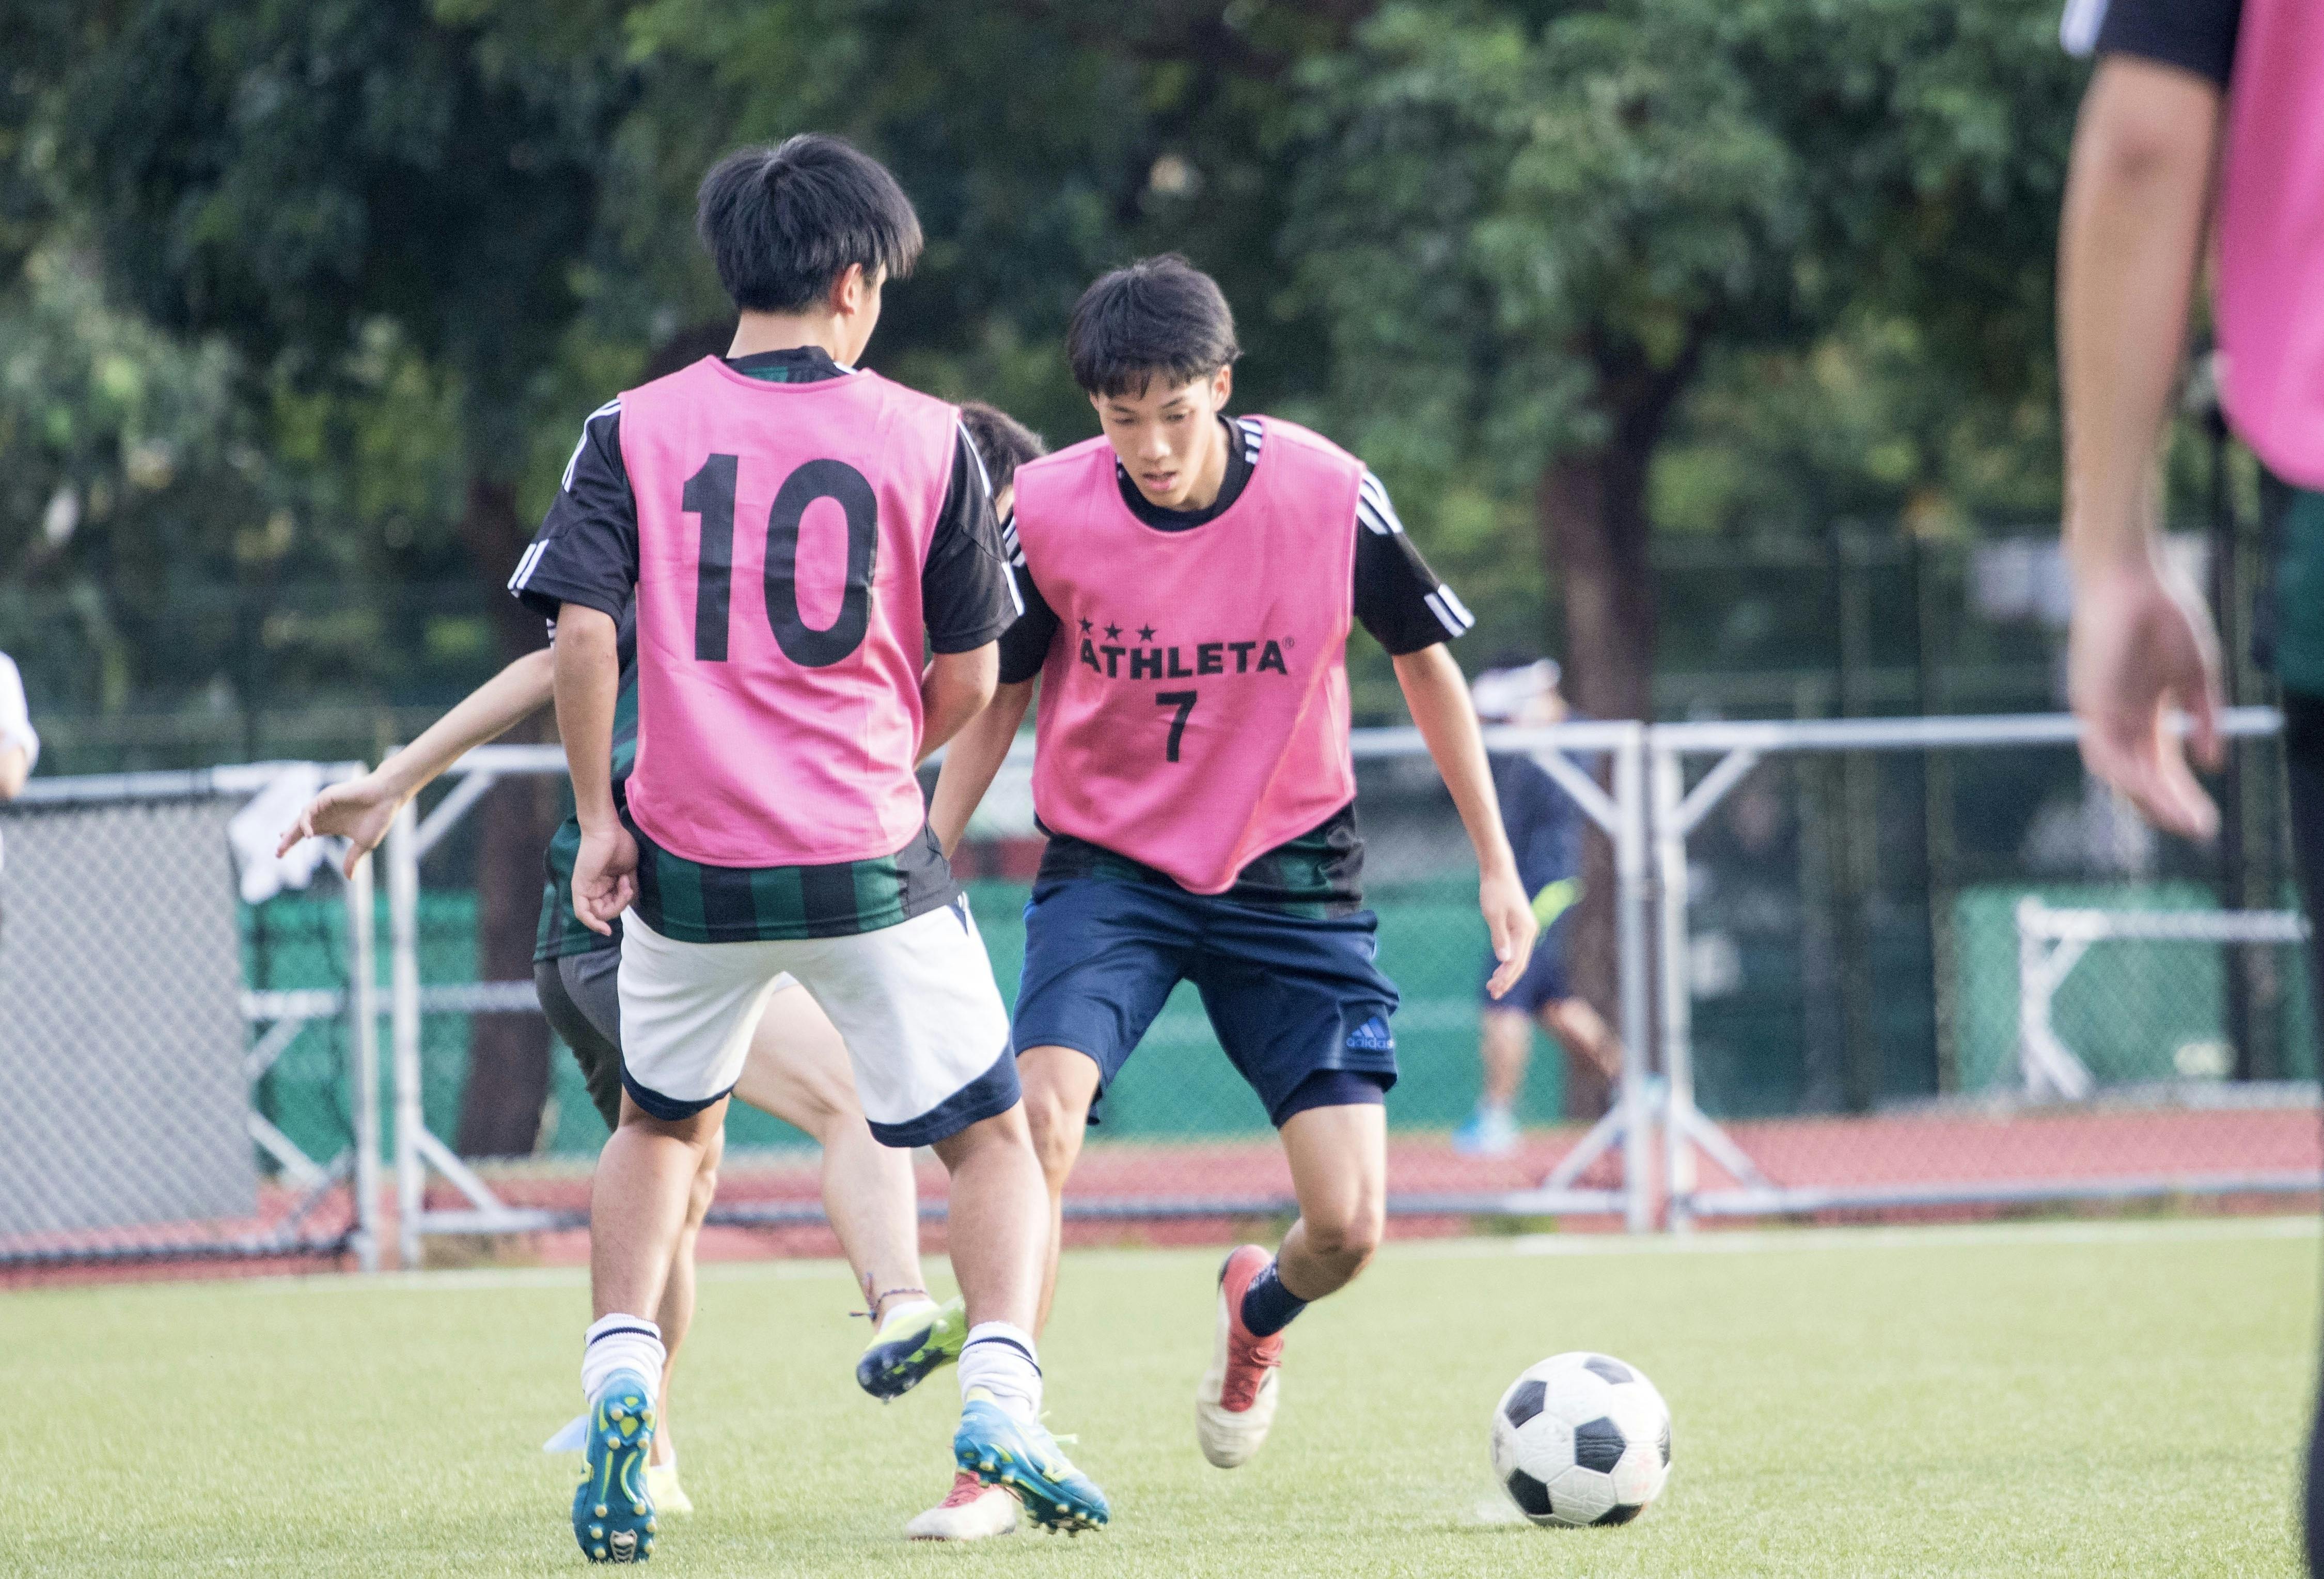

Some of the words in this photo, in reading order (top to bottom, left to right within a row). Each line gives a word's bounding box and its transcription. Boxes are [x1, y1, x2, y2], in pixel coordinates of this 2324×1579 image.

[681, 453, 878, 667] 10
[1155, 690, 1198, 762] 7
[1346, 1036, 1394, 1050] adida
